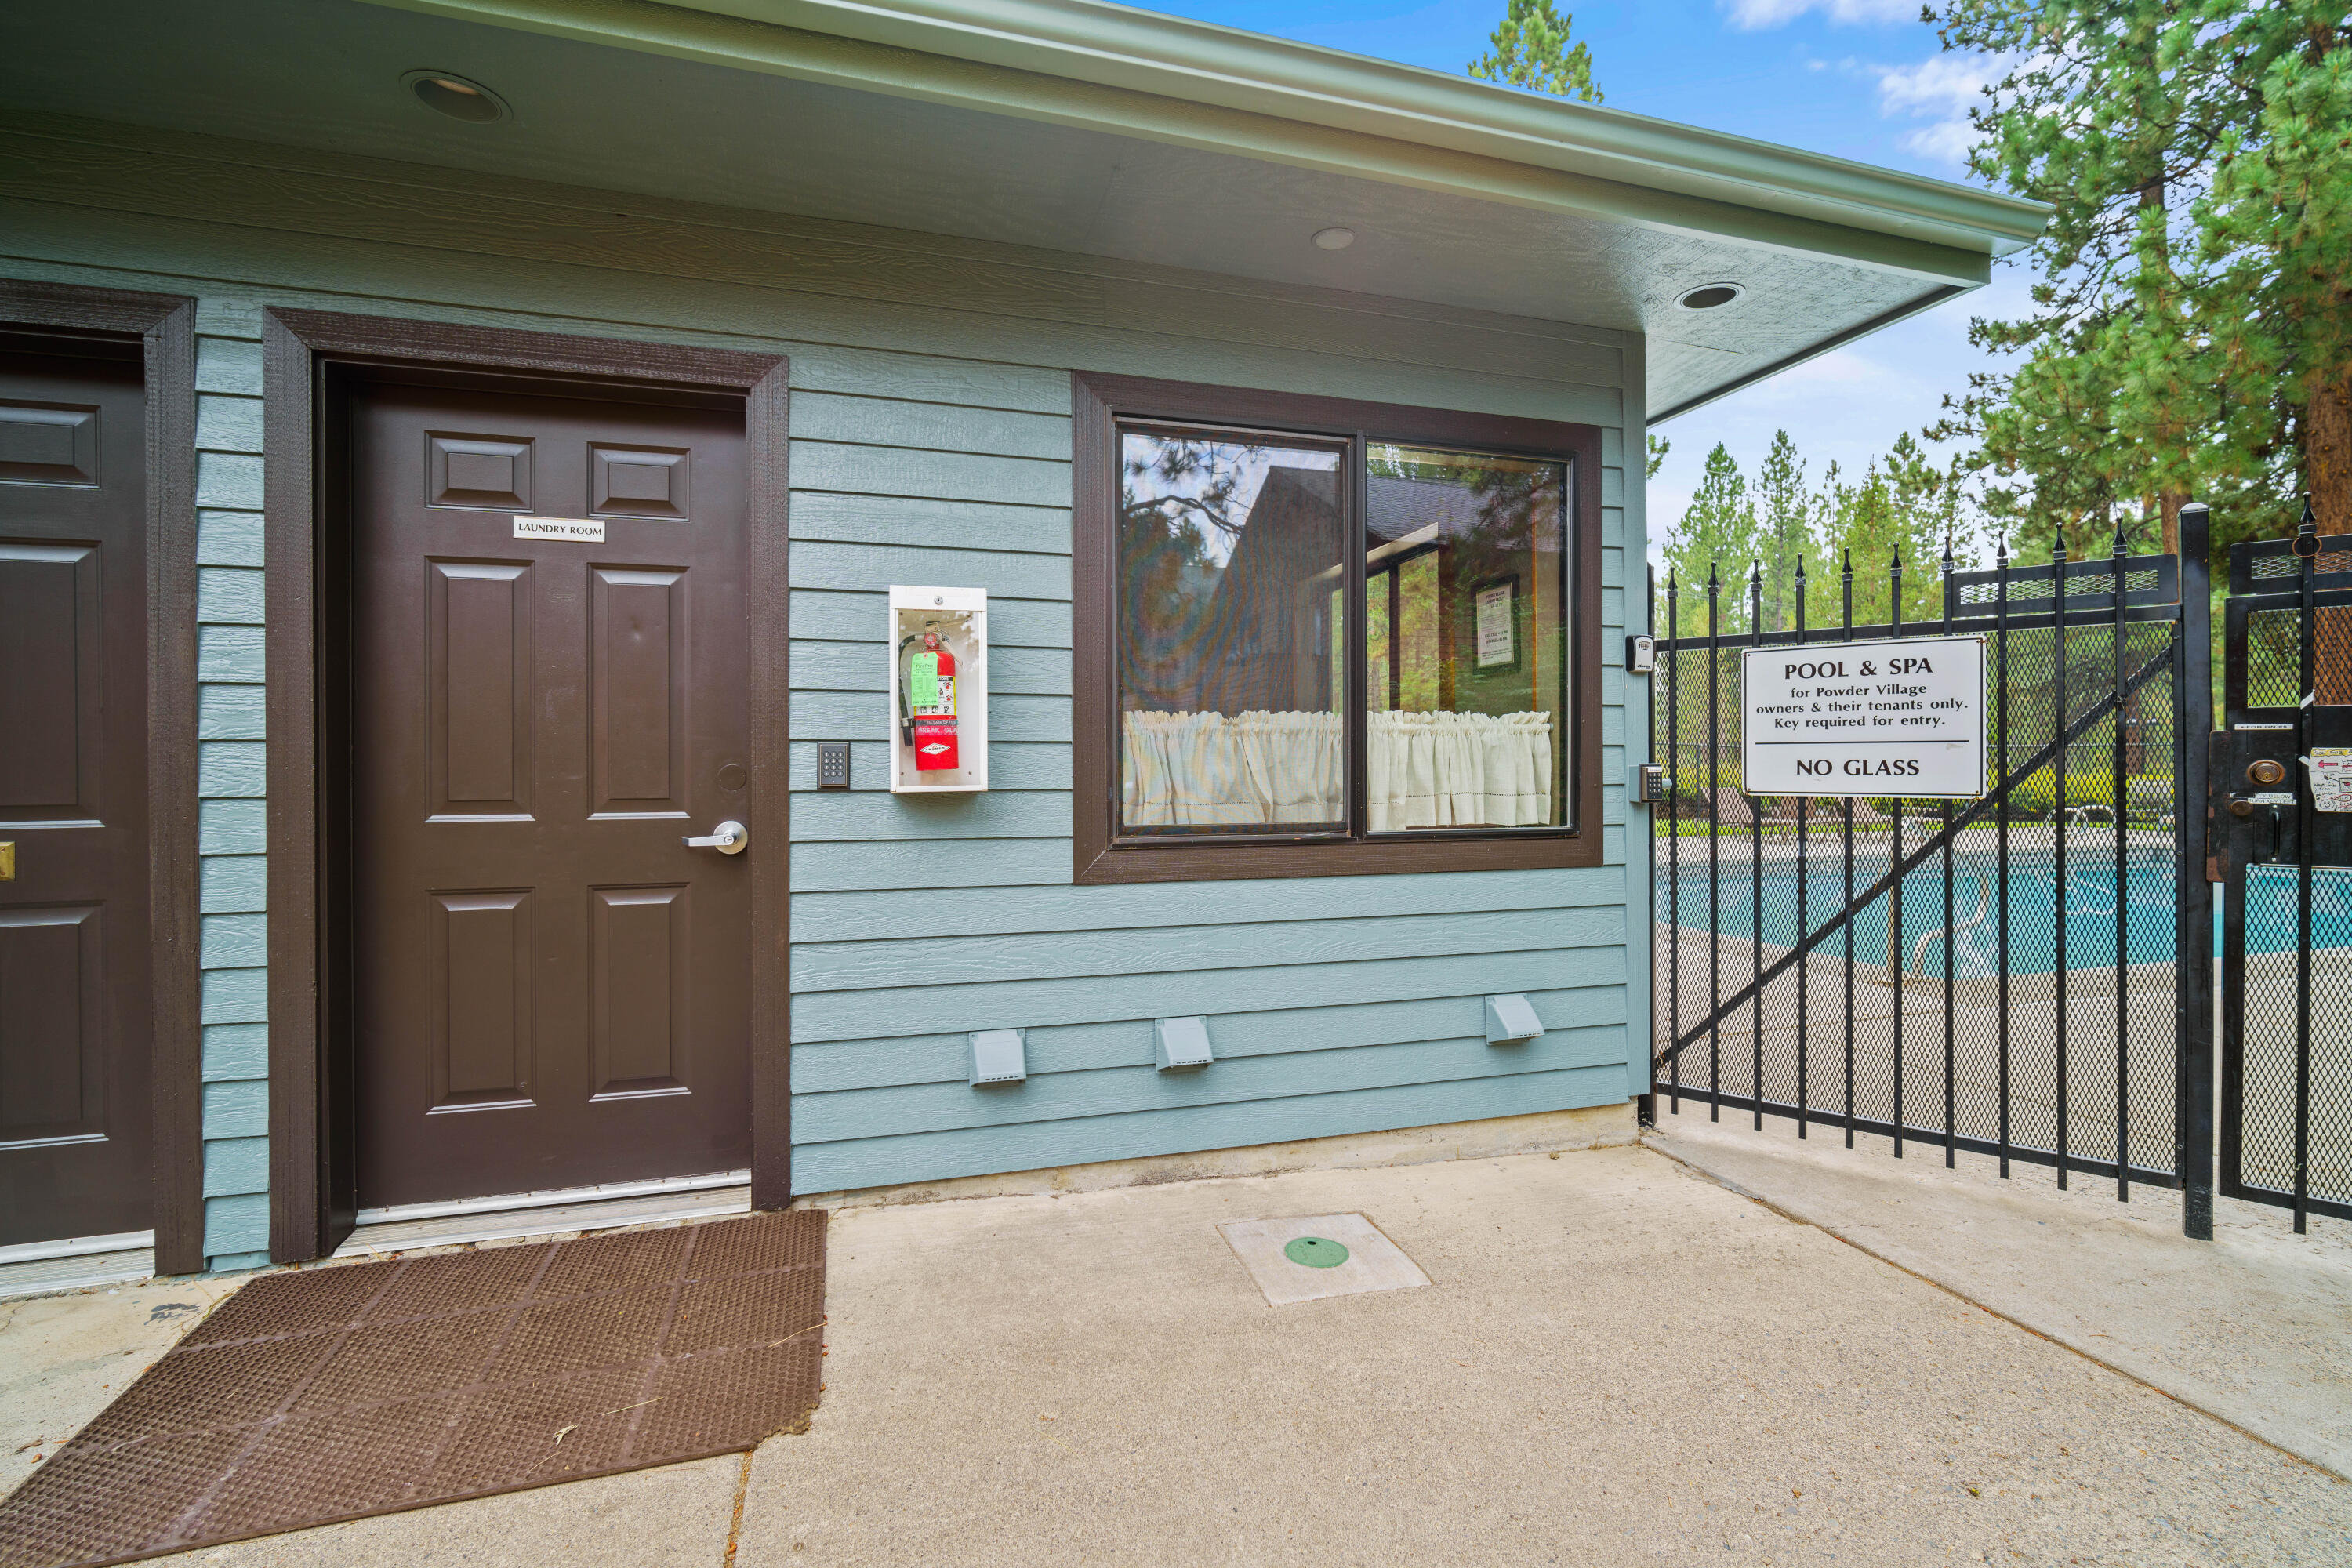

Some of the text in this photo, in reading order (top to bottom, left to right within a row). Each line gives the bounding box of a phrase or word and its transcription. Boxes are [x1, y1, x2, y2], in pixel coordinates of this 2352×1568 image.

[518, 523, 602, 535] LAUNDRY ROOM
[1784, 657, 1933, 680] POOL & SPA
[1791, 683, 1927, 698] for Powder Village
[1756, 697, 1969, 714] owners & their tenants only.
[1774, 715, 1945, 731] Key required for entry.
[1796, 759, 1920, 776] NO GLASS
